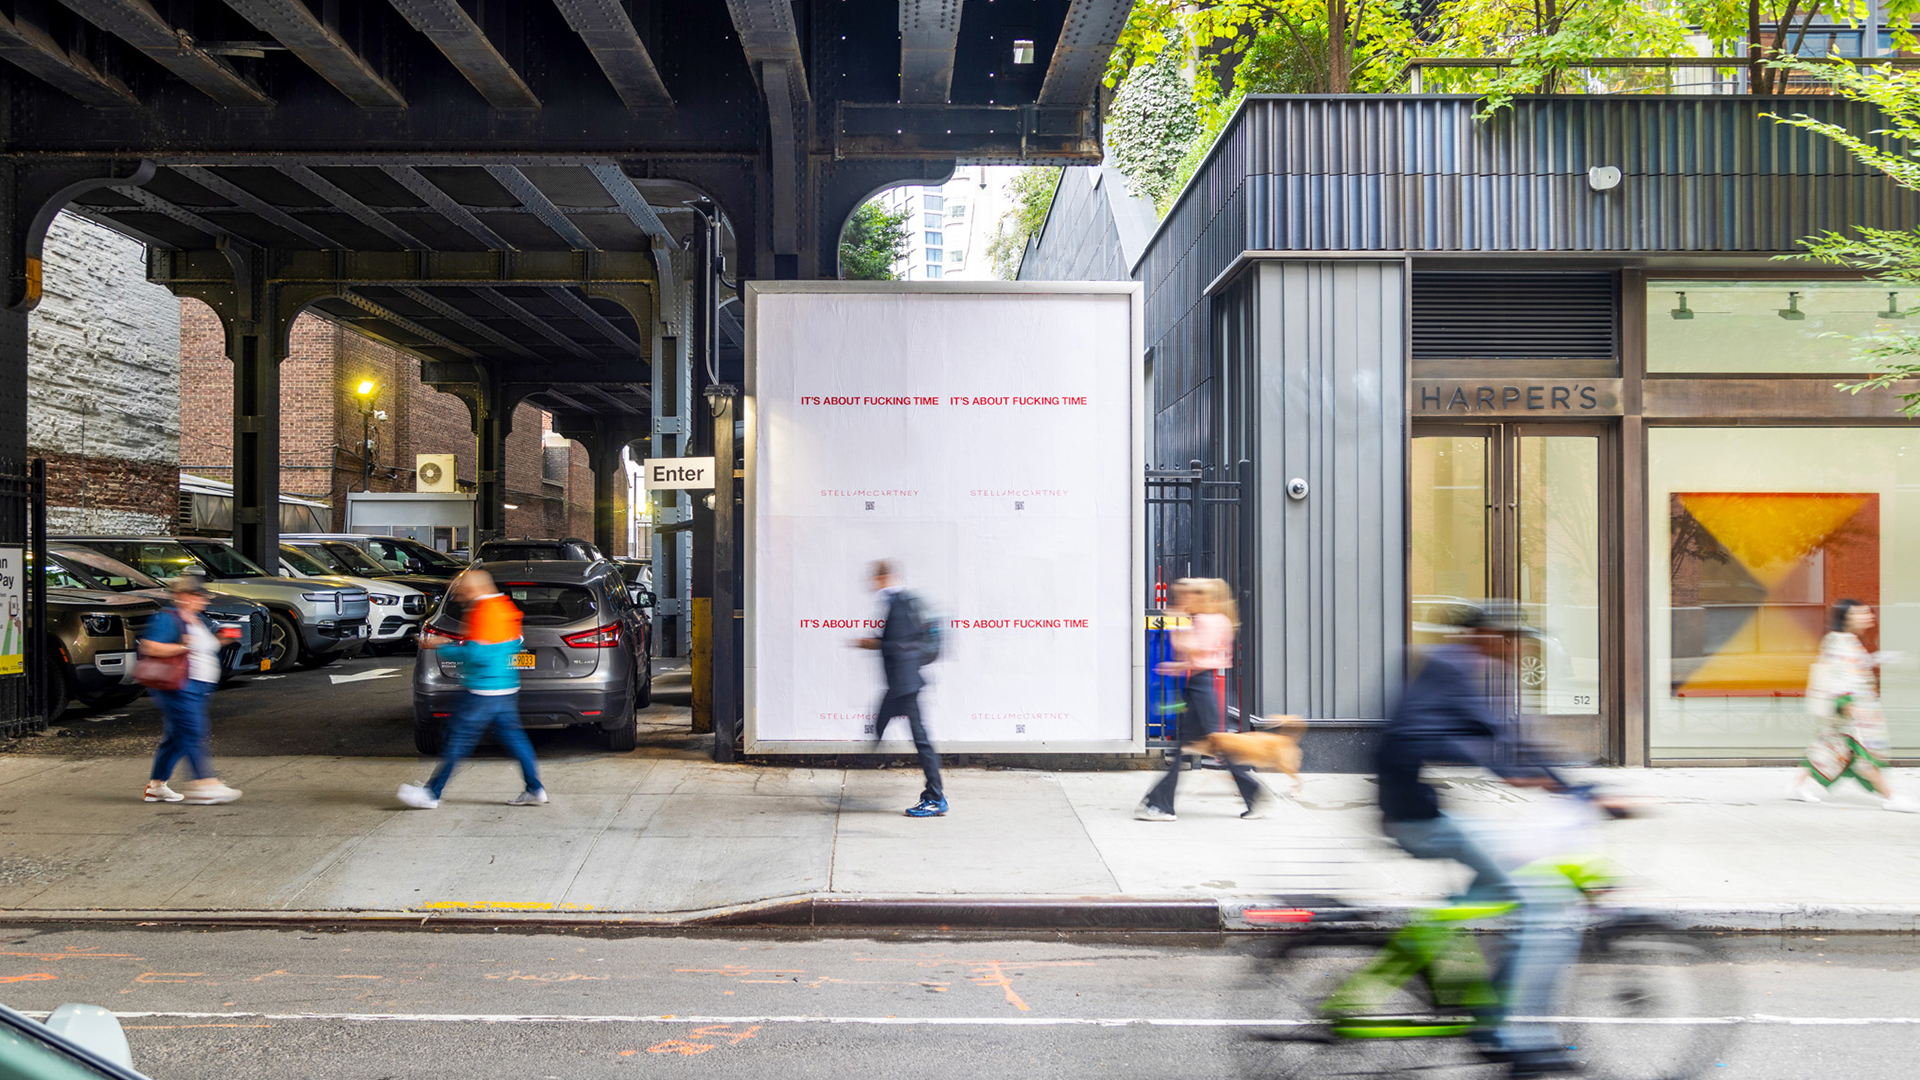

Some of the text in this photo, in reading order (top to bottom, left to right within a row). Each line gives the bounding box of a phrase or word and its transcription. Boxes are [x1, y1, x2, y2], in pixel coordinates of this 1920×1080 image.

[801, 396, 939, 406] IT'S ABOUT FUCKING TIME
[950, 396, 1087, 406] IT'S ABOUT FUCKING TIME
[1421, 384, 1597, 410] HARPER'S
[653, 465, 704, 482] Enter
[800, 619, 820, 629] IT'S
[822, 619, 860, 629] ABOUT
[950, 619, 1089, 629] IT'S ABOUT FUCKING TIME
[1574, 696, 1591, 705] 512
